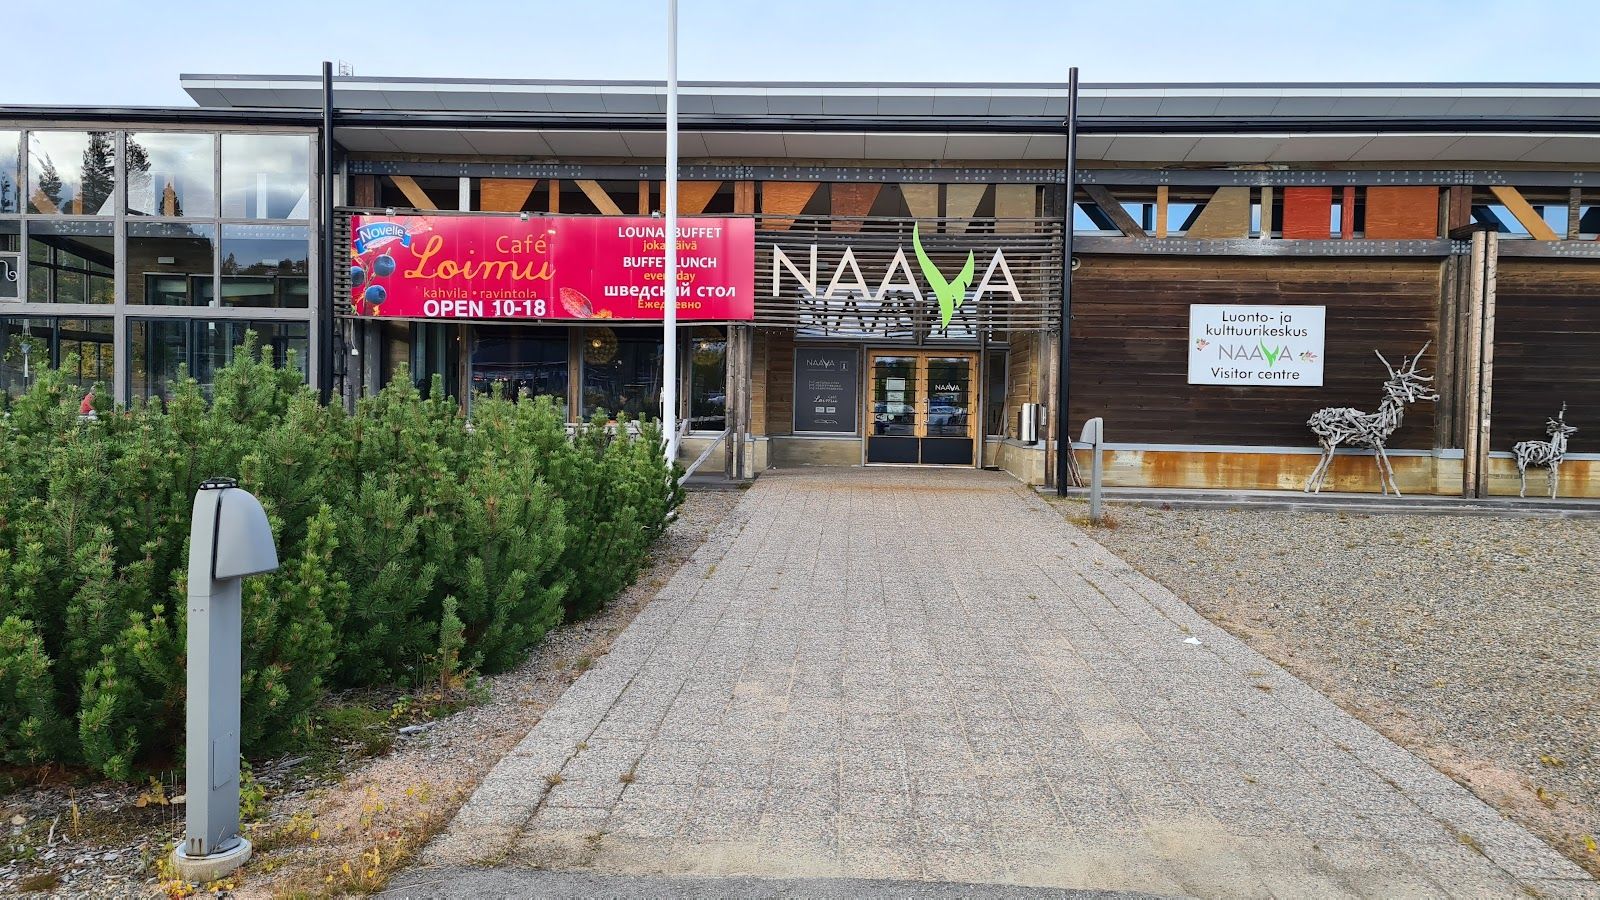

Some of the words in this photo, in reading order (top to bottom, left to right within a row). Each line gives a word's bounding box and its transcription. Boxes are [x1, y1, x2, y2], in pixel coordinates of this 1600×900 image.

[359, 224, 405, 243] Novelle
[496, 234, 547, 254] Café
[675, 241, 698, 251] äivä
[404, 235, 556, 281] Loimu
[773, 221, 1022, 330] NAAVA
[423, 287, 468, 299] kahvila
[480, 287, 537, 299] ravintola
[697, 286, 736, 297] стол
[423, 300, 483, 317] OPEN
[492, 299, 546, 316] 10-18
[637, 299, 702, 309] Ежедевно
[1222, 311, 1274, 323] Luonto-
[1280, 311, 1292, 326] ja
[1206, 324, 1308, 337] kulttuurikeskus
[1218, 338, 1293, 368] NAAVA
[1211, 367, 1253, 379] Visitor
[1258, 369, 1300, 380] centre
[934, 382, 960, 392] NAAVA
